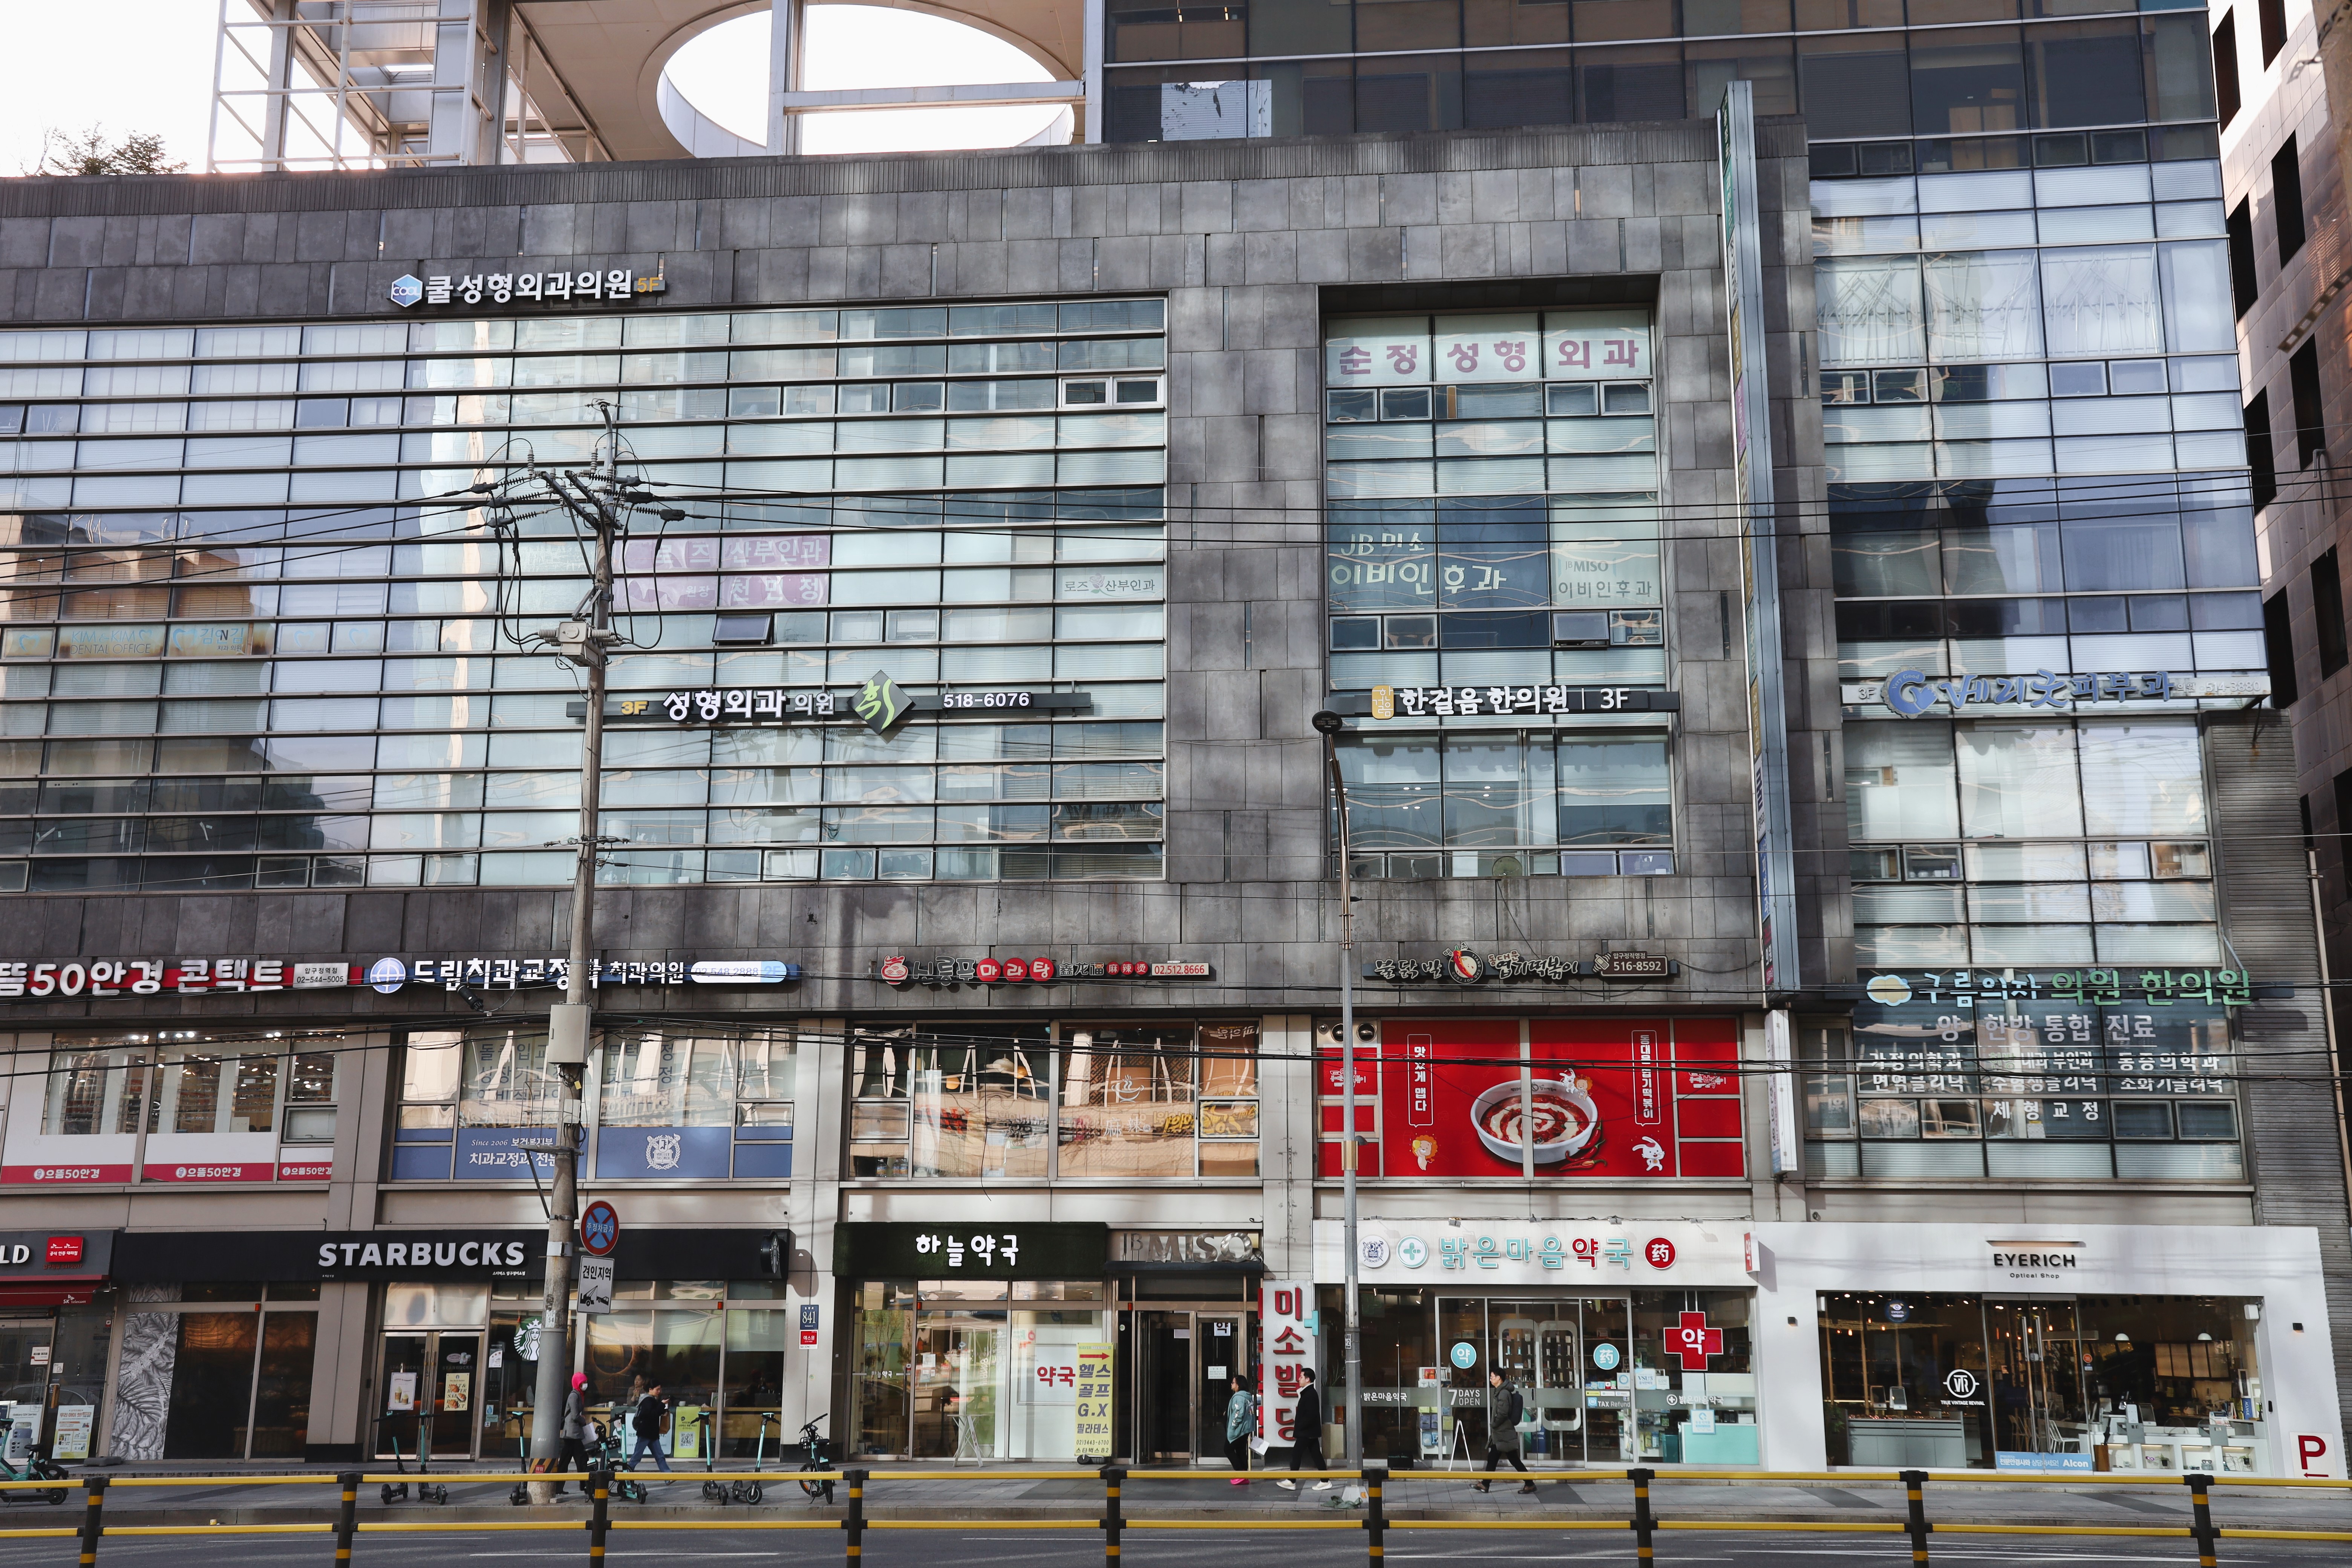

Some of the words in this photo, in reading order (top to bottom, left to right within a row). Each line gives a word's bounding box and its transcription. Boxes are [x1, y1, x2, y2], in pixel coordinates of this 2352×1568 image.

[426, 269, 632, 304] 쿨성형외과의원
[637, 277, 660, 293] 5F
[657, 544, 710, 564] 로즈
[730, 539, 822, 564] 산부인과
[1341, 533, 1374, 556] JB
[1382, 532, 1426, 552] 미소
[1574, 561, 1609, 572] MISO
[1064, 580, 1089, 592] 로즈
[1104, 579, 1155, 592] 산부인과
[1331, 562, 1507, 595] 이비인후과
[685, 585, 710, 599] 원장
[1559, 580, 1652, 599] 이비인후과
[72, 630, 96, 643] KIM
[111, 630, 136, 643] KIM
[70, 644, 109, 655] DENTAL
[112, 643, 151, 654] OFFICE
[1859, 688, 1877, 699] 3F
[2206, 680, 2261, 693] 514-3880
[621, 700, 648, 715] 3F
[663, 689, 787, 722] 성형외과
[794, 692, 835, 716] 의원
[942, 691, 1031, 708] 518-6076
[1399, 686, 1483, 716] 한걸음
[1487, 684, 1570, 714] 한의원
[1600, 688, 1629, 709] 3F
[1489, 950, 1519, 966] 동대문
[1613, 961, 1661, 971] 516-8592
[764, 966, 781, 977] 2F
[980, 961, 1050, 978] 마라탕
[1108, 962, 1146, 974] 麻辣烫
[1154, 965, 1205, 975] 02.512.8666
[1374, 959, 1442, 980] 불닭발
[1496, 955, 1579, 980] 엽기떡볶이
[2044, 1014, 2092, 1042] 통합
[2107, 1014, 2156, 1041] 진료
[479, 1043, 531, 1061] 돌입
[1414, 1087, 1427, 1112] 맵다
[1992, 1101, 2099, 1121] 체형교정
[469, 1152, 533, 1167] 치과교정과
[44, 1168, 100, 1179] 으뜸50안경
[187, 1167, 242, 1178] 으뜸50안경
[291, 1167, 332, 1176] 으뜸50안경
[586, 1222, 614, 1234] 주정차금지
[318, 1242, 525, 1266] STARBUCKS
[915, 1234, 1019, 1267] 하늘약국
[1146, 1232, 1254, 1263] MISO
[1439, 1236, 1633, 1269] 밝은마음약국
[1650, 1243, 1671, 1262] 药
[1993, 1253, 2076, 1268] EYERICH
[582, 1265, 612, 1281] 견인지역
[802, 1311, 816, 1324] 841
[1681, 1328, 1705, 1355] 약
[1456, 1348, 1471, 1364] 약
[1599, 1349, 1614, 1364] 药
[1037, 1366, 1075, 1387] 약국
[1079, 1363, 1111, 1379] 헬스
[1079, 1384, 1111, 1398] 골프
[1363, 1392, 1407, 1402] 밝은마음약국
[1448, 1389, 1457, 1406] 7
[1458, 1389, 1480, 1397] DAYS
[1459, 1398, 1480, 1406] OPEN
[1076, 1423, 1109, 1435] 필라테스
[2298, 1435, 2326, 1470] P
[2062, 1459, 2089, 1468] Alcon
